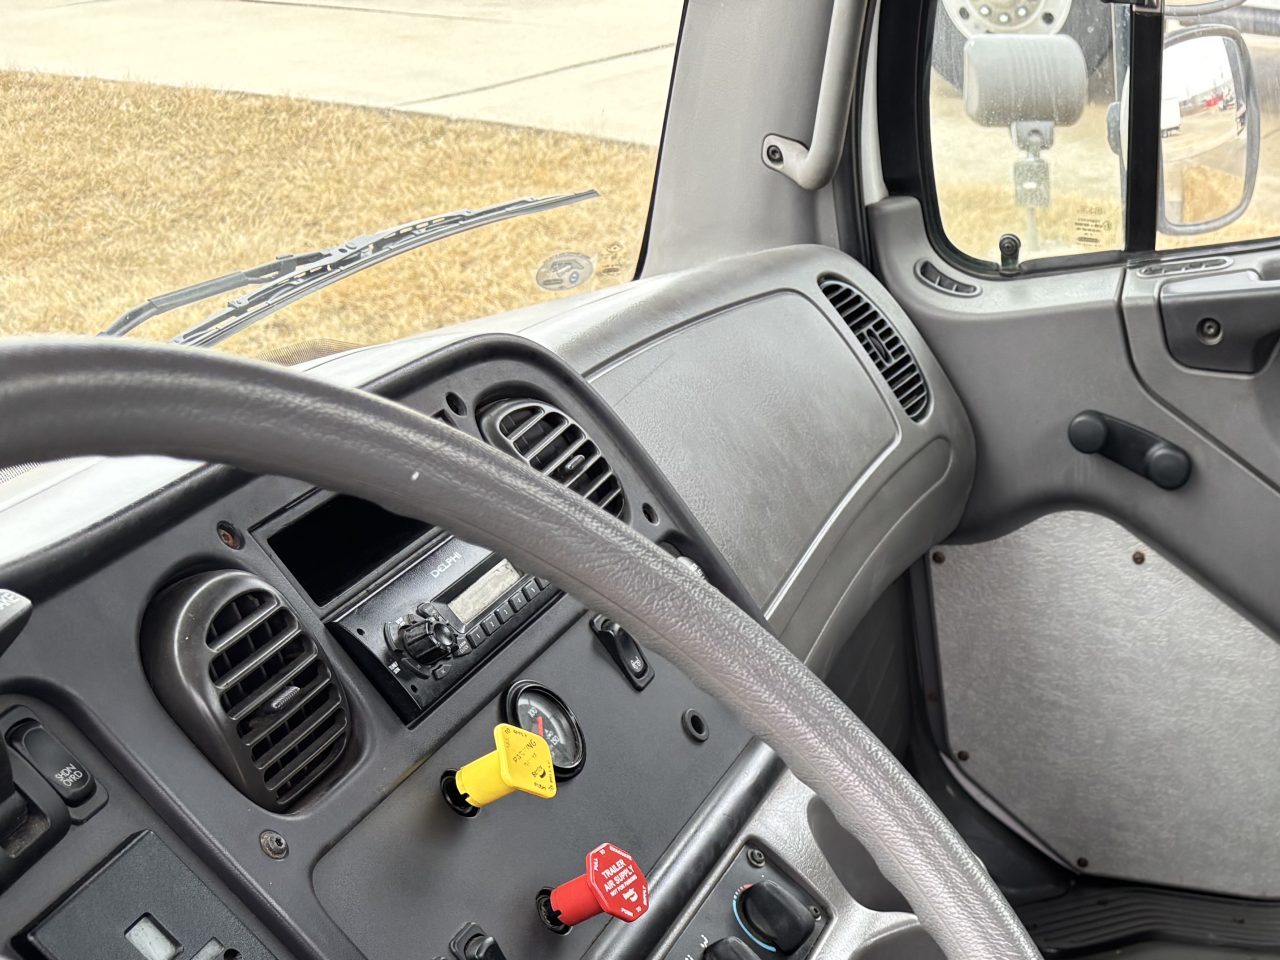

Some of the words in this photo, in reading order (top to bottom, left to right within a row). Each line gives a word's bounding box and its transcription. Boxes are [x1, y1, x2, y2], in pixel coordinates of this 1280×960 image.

[430, 551, 462, 578] DELPHI
[54, 763, 77, 781] SHDN
[62, 770, 83, 787] OVRD
[601, 858, 627, 880] TRAILER
[604, 879, 616, 893] AIR
[613, 864, 635, 884] SUPPLY
